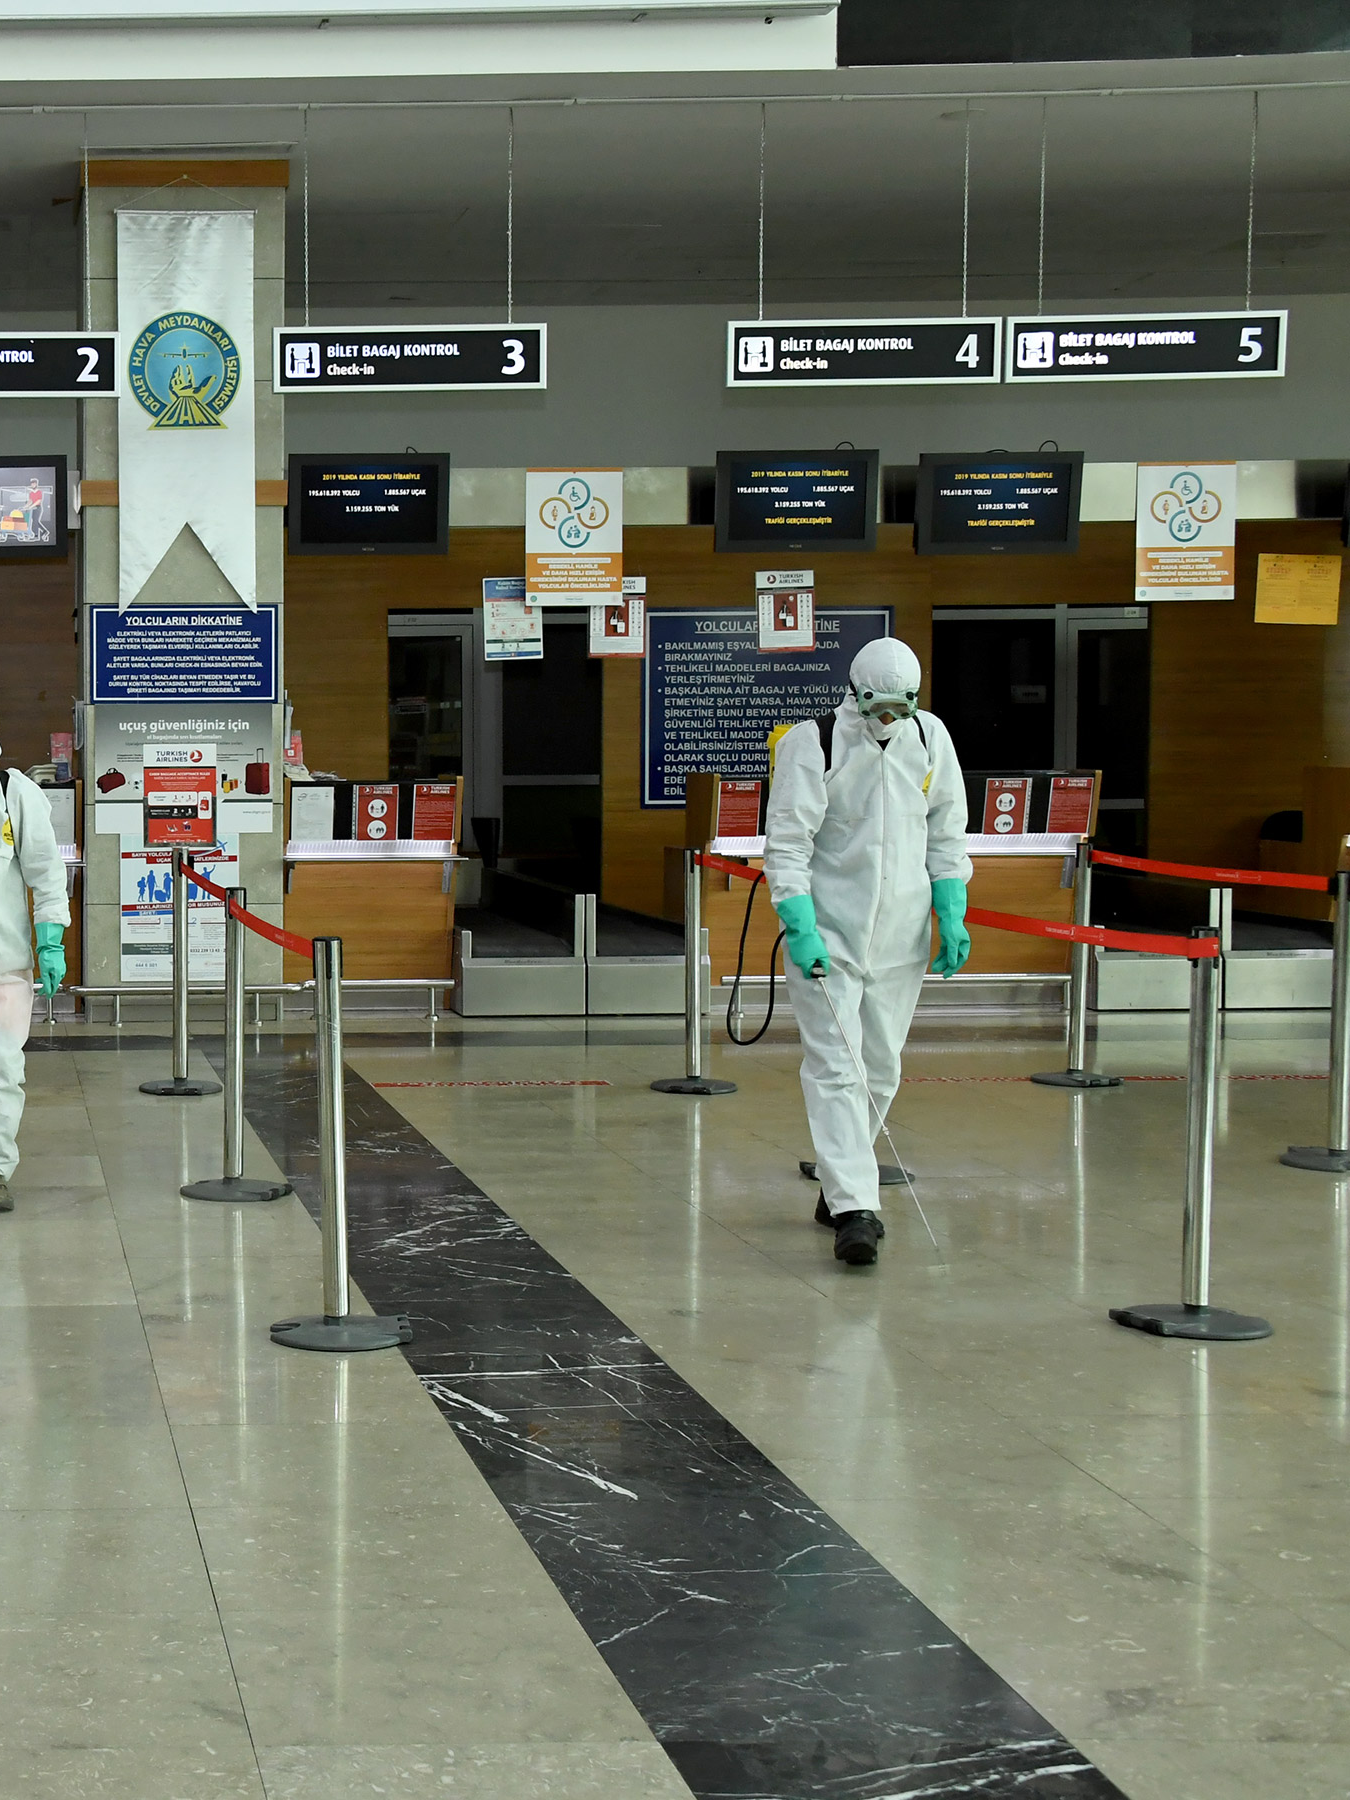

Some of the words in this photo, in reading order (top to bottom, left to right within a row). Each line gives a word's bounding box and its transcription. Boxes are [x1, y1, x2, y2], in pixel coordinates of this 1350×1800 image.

[158, 315, 232, 351] MEYDANLARI
[1059, 332, 1093, 348] BİLET
[1095, 333, 1135, 348] BAGAJ
[1137, 331, 1195, 345] KONTROL
[132, 332, 156, 367] HAVA
[327, 343, 358, 358] BİLET
[362, 345, 401, 359] BAGAJ
[404, 344, 460, 357] KONTROL
[780, 337, 812, 351] BİLET
[816, 339, 855, 353] BAGAJ
[857, 338, 913, 350] KONTROL
[955, 334, 979, 368] 4
[1237, 327, 1262, 362] 5
[76, 347, 99, 382] 2
[501, 339, 526, 375] 3
[780, 358, 828, 369] Check-in
[1058, 353, 1108, 365] Check-in
[327, 364, 375, 375] Check-in
[212, 356, 239, 412] İŞLETMESİ
[133, 374, 160, 412] DEVLET
[388, 504, 399, 512] YÜK
[125, 617, 189, 626] YOLCULARIN
[191, 614, 242, 625] DİKKATİNE
[664, 641, 724, 651] BAKILMAMIŞ
[664, 653, 732, 661] BIRAKMAYINIZ
[664, 663, 713, 673] TEHLİKELİ
[715, 662, 771, 672] MADDELERİ
[773, 663, 830, 671] BAGAJINIZA
[664, 674, 755, 685] YERLEŞTİRMEYİNİZ
[664, 686, 733, 696] BAŞKALARINA
[735, 685, 750, 694] AİT
[752, 686, 785, 694] BAGAJ
[788, 686, 800, 694] VE
[803, 684, 829, 694] YÜKÜ
[119, 721, 147, 733] uçuş
[150, 719, 226, 733] güvenliğiniz
[228, 719, 250, 732] için
